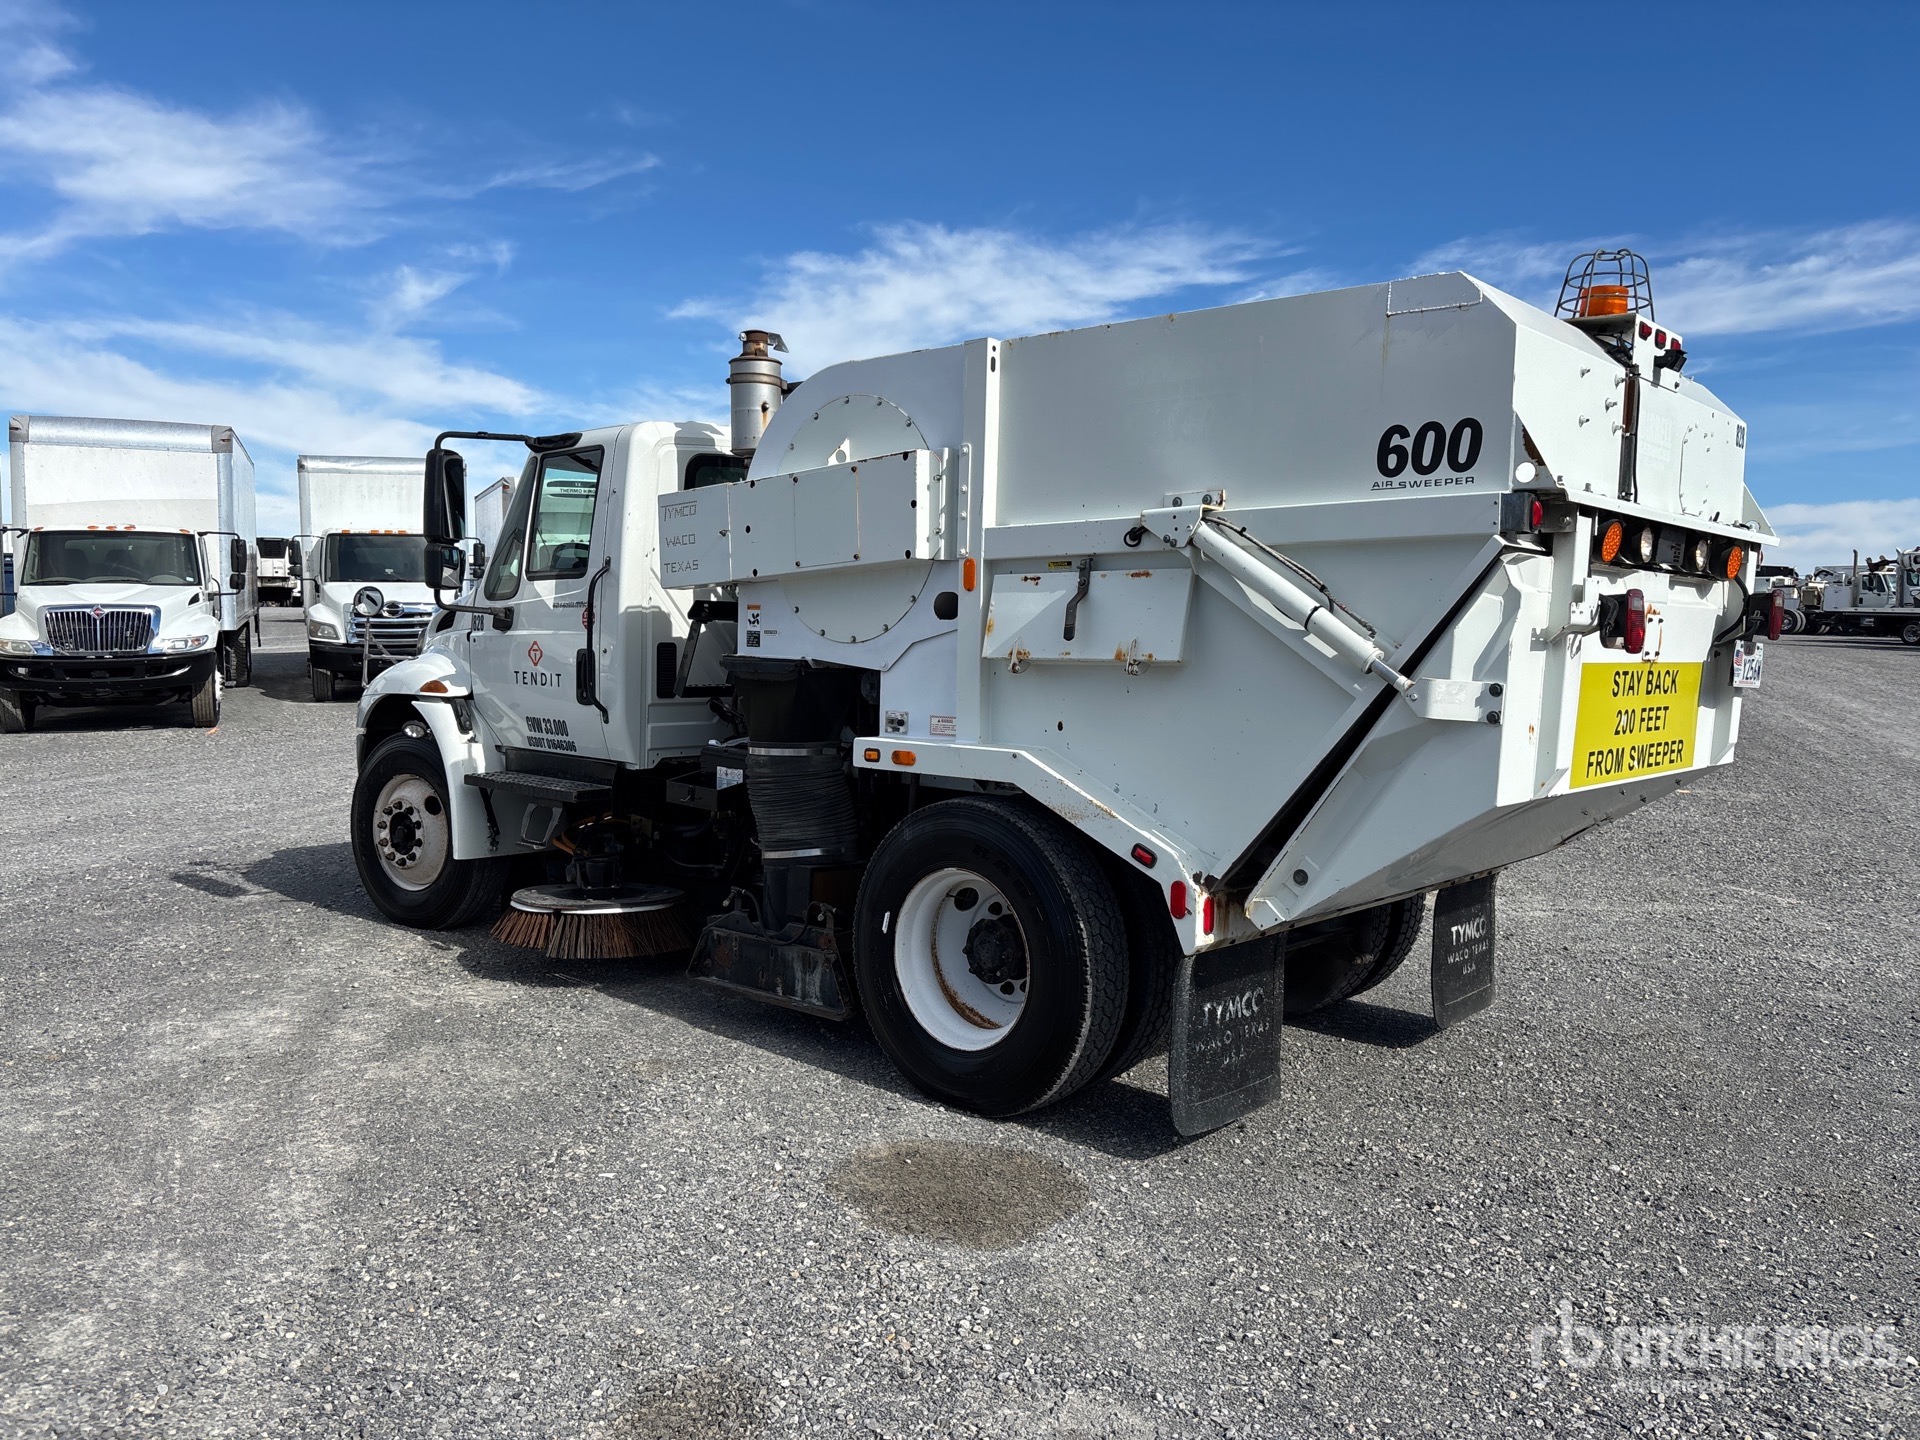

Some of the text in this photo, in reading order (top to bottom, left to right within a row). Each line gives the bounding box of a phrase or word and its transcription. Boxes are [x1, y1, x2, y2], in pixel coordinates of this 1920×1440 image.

[1377, 417, 1483, 478] 600
[1371, 476, 1475, 490] AIR SWEEPER
[661, 501, 698, 522] TYMCO
[665, 534, 696, 548] WACO
[663, 560, 699, 574] TEXAS
[513, 670, 562, 688] TENDIT
[1612, 669, 1680, 698] STAY BACK
[526, 715, 569, 738] GVW 33,000
[1614, 705, 1669, 736] 200 FEET
[526, 735, 546, 749] USDOT
[1586, 739, 1684, 779] FROM SWEEPER
[1451, 916, 1486, 946] TYMCO
[1447, 948, 1469, 965] WACO
